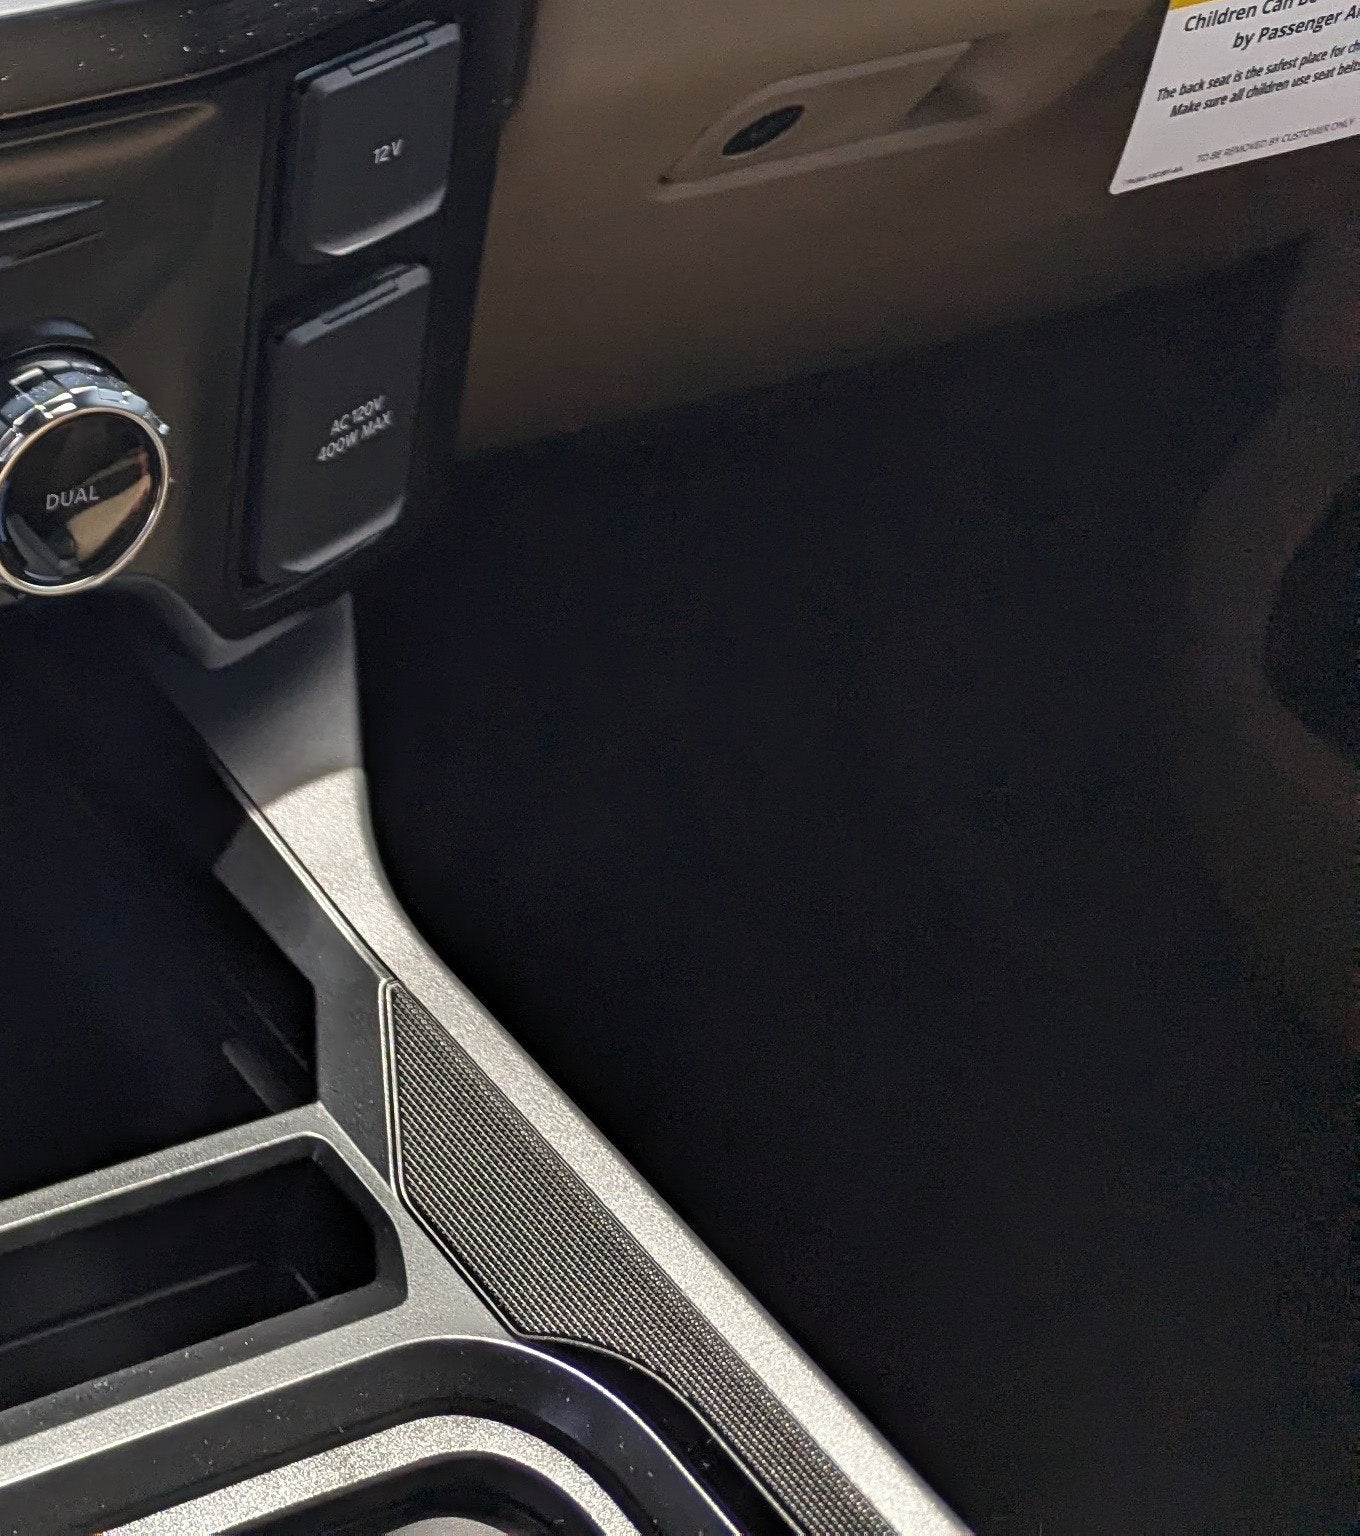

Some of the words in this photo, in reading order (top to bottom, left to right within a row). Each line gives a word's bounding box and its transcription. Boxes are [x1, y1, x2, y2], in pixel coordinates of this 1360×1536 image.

[1185, 5, 1257, 31] Children
[1233, 32, 1255, 50] by
[1258, 11, 1342, 43] Passenger
[1157, 87, 1176, 101] The
[1179, 79, 1204, 96] back
[1207, 73, 1232, 89] seat
[1233, 70, 1242, 82] is
[1245, 66, 1264, 80] the
[1265, 57, 1299, 75] safest
[1298, 50, 1328, 69] place
[1330, 44, 1346, 59] for
[1170, 100, 1202, 117] Make
[1203, 95, 1228, 109] sure
[1230, 88, 1245, 102] all
[1246, 79, 1289, 98] children
[1291, 74, 1310, 87] use
[1312, 66, 1335, 82] seat
[331, 414, 349, 435] AC
[361, 411, 392, 439] MAX
[45, 483, 100, 509] DUAL
